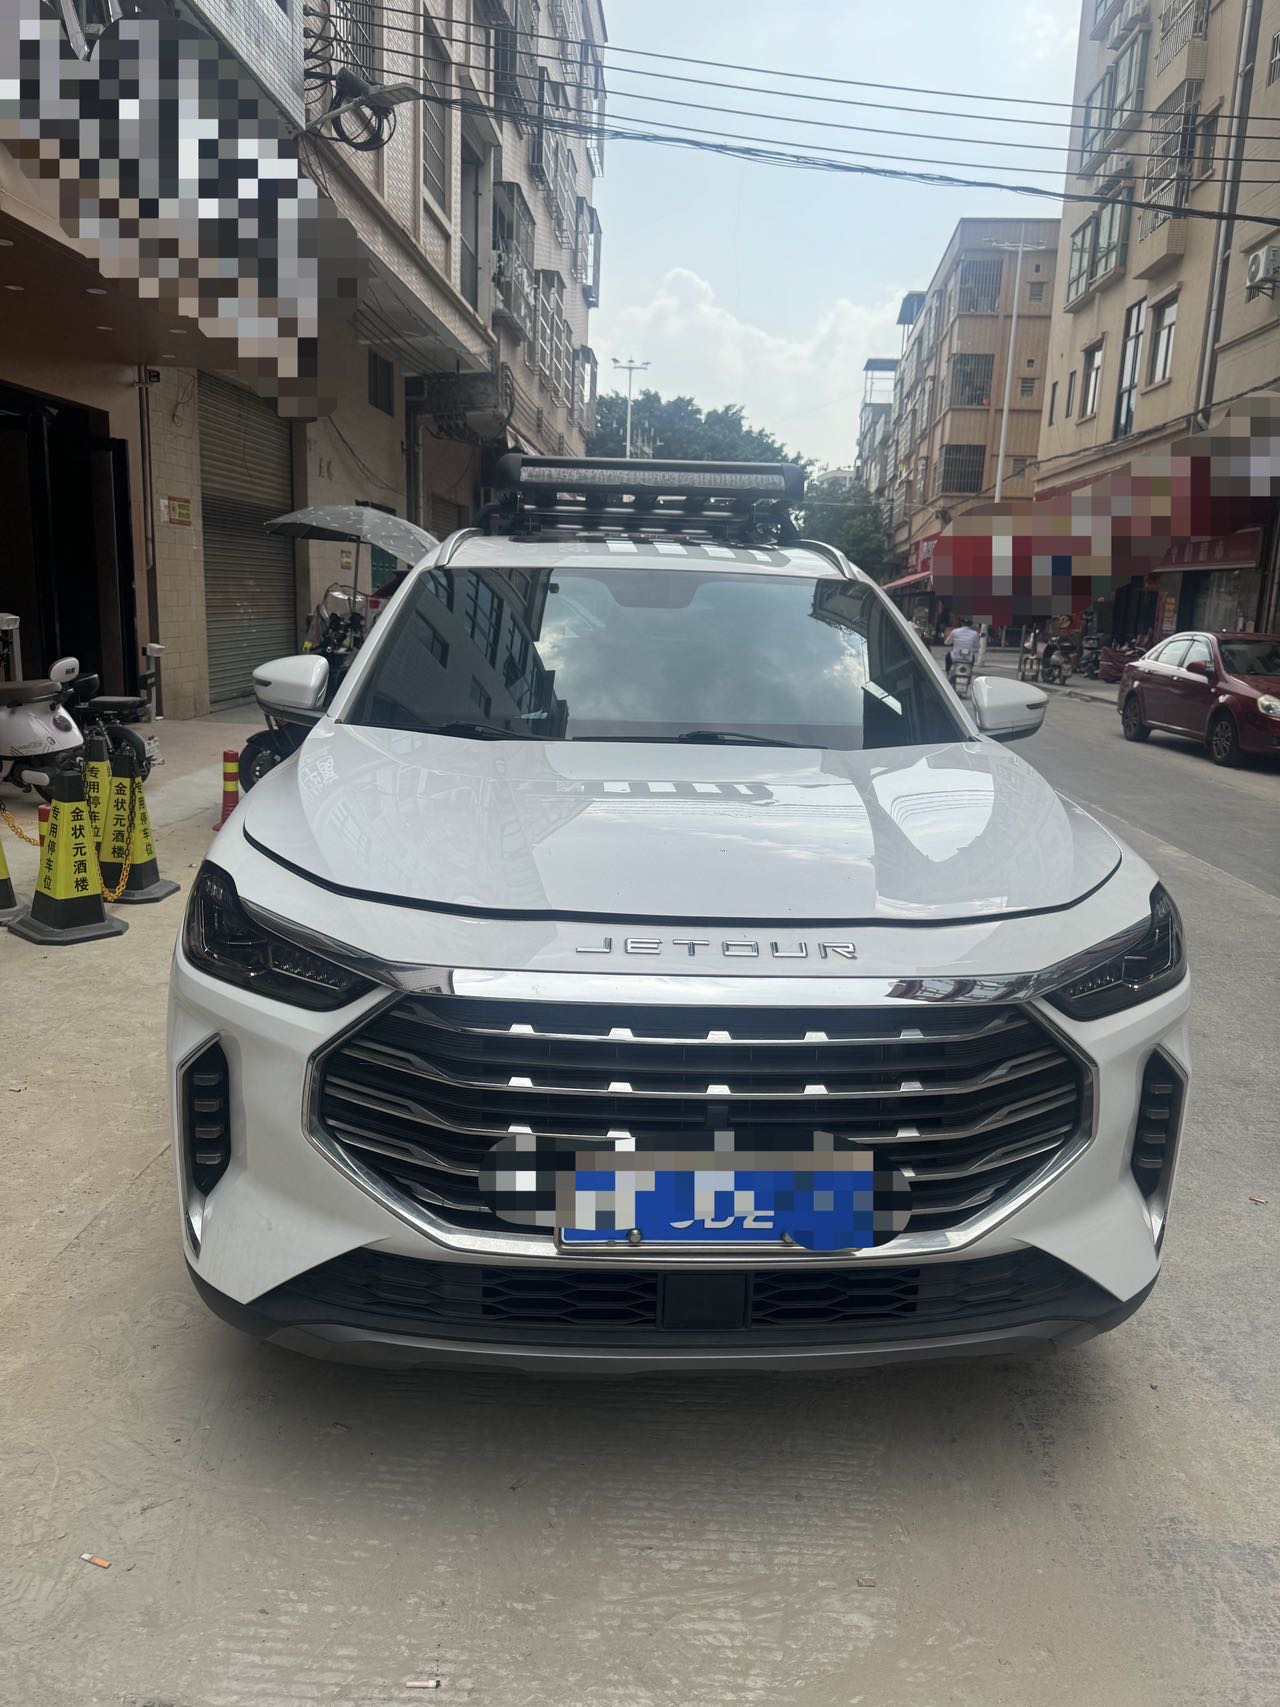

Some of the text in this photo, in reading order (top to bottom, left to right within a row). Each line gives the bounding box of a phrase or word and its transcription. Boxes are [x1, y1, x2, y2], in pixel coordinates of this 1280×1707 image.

[43, 806, 60, 891] 专用停车位
[70, 806, 89, 893] 金状元酒楼
[111, 782, 128, 859] 金状元酒楼
[576, 937, 858, 960] JETOUR
